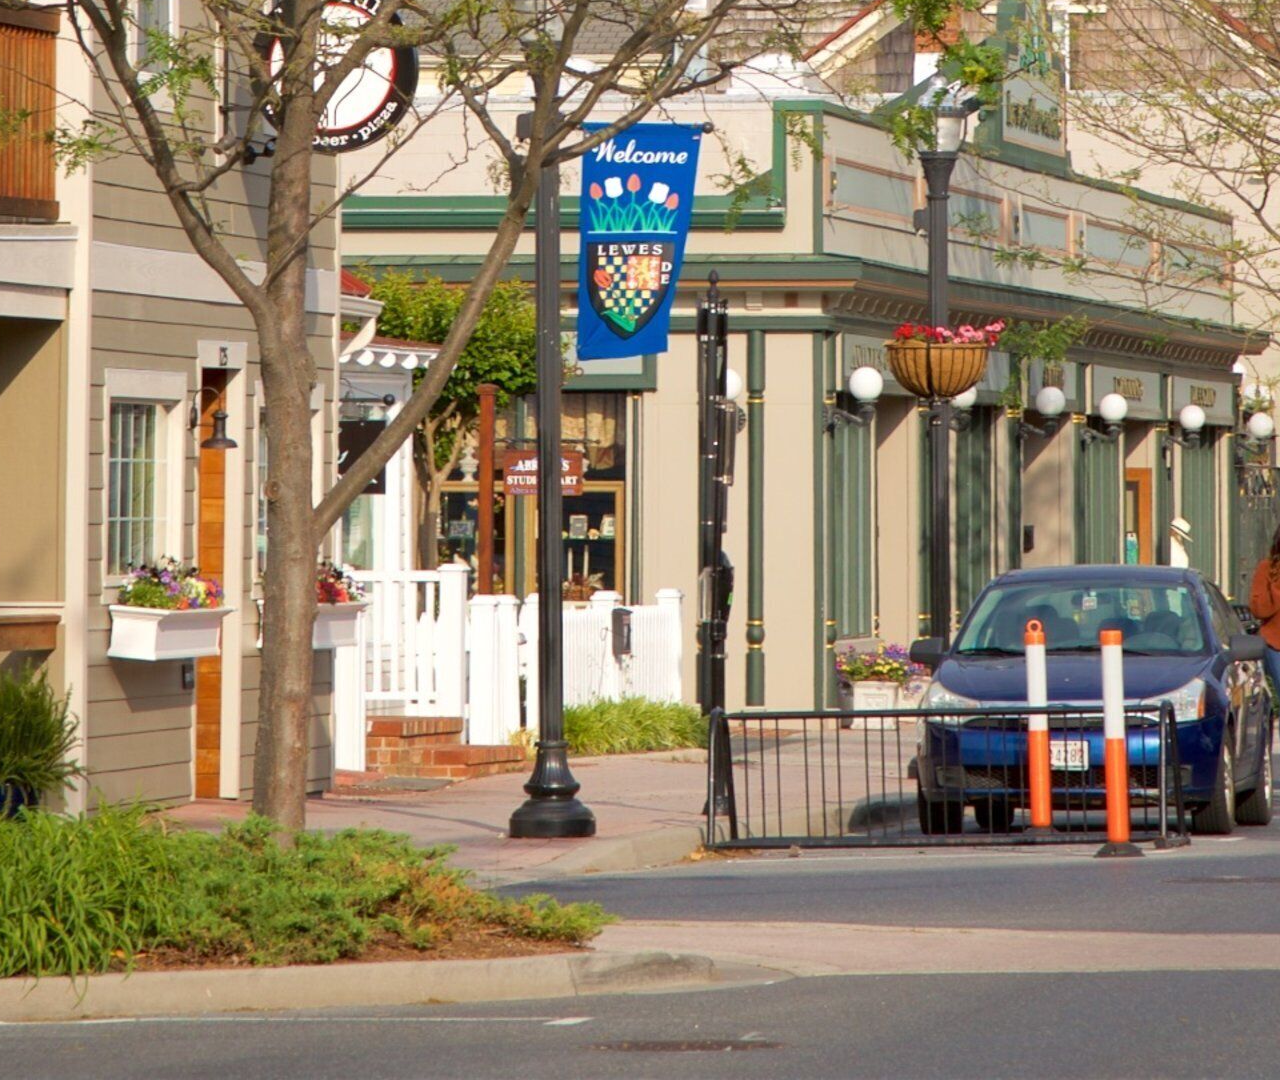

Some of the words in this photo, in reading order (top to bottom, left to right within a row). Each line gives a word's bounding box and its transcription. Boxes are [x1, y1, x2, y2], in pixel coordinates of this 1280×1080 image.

[358, 101, 398, 140] pizza
[591, 138, 689, 165] Welcome
[597, 244, 664, 257] LEWES
